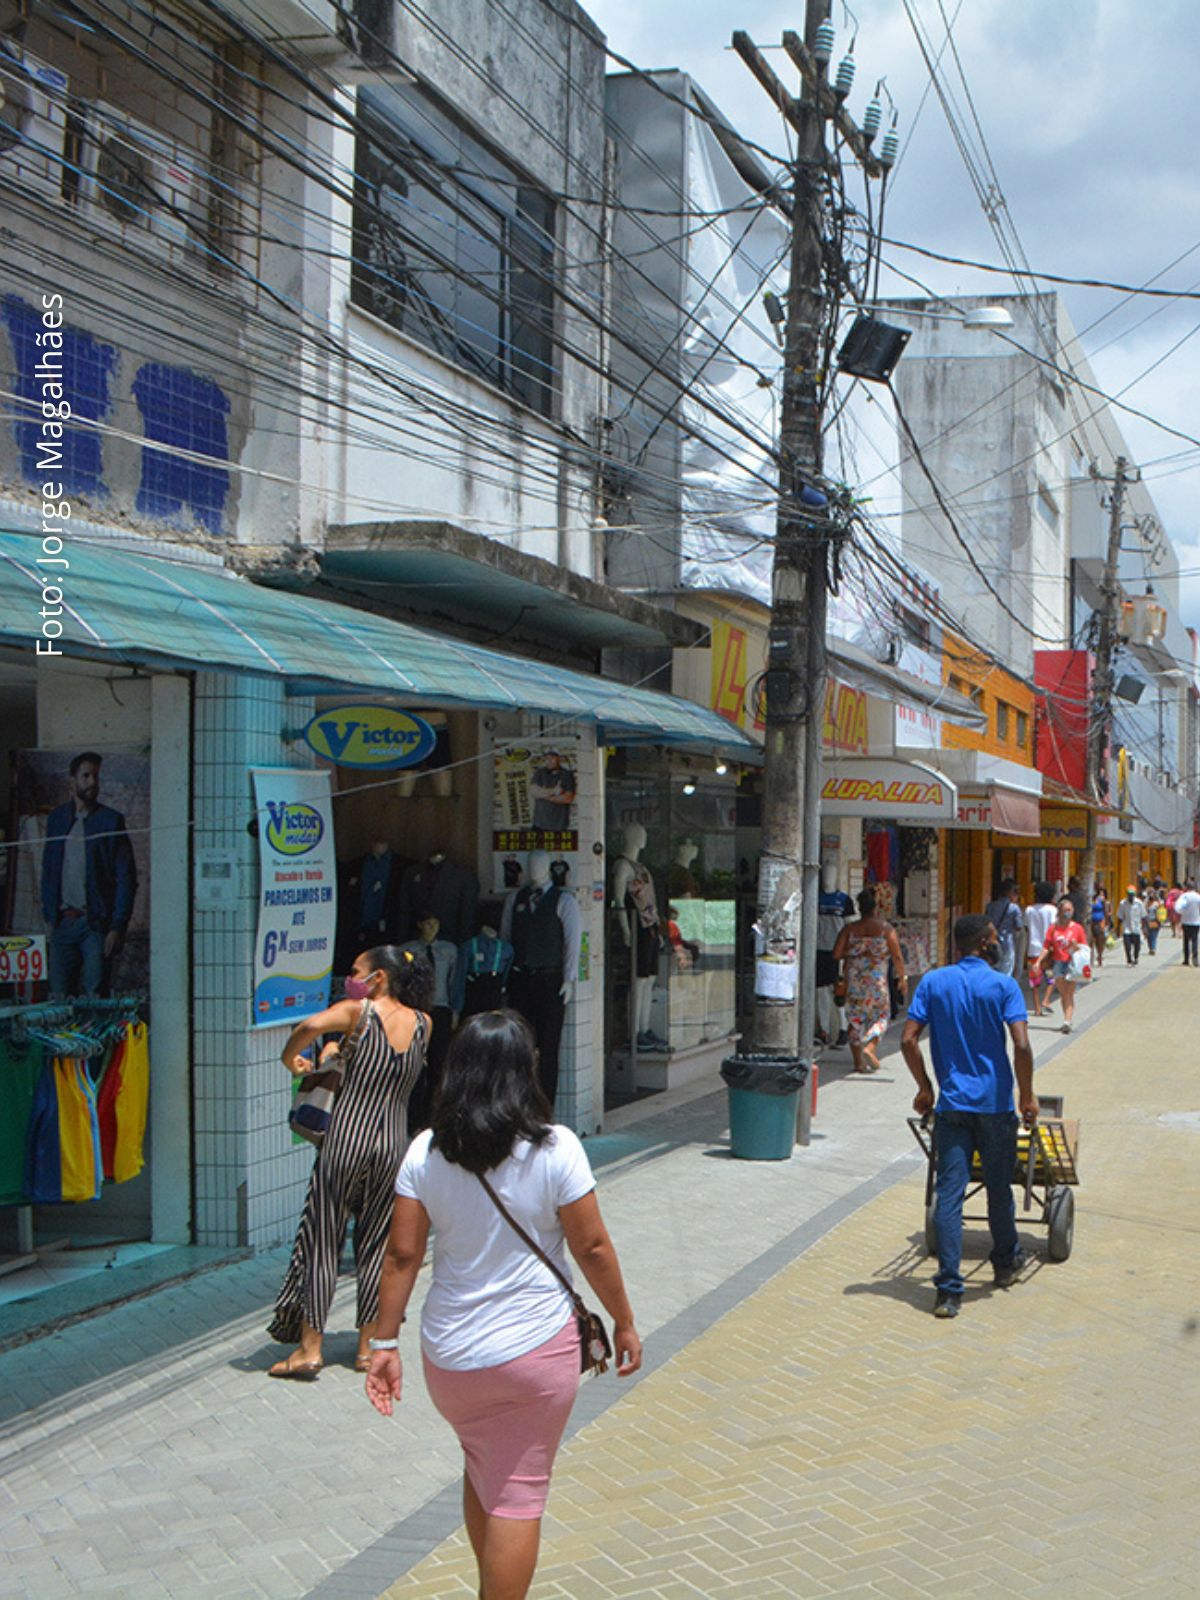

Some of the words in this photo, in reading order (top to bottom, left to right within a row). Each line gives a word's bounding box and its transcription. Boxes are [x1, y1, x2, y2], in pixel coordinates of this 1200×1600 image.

[317, 721, 420, 760] Victor
[265, 800, 319, 836] Victor
[263, 887, 319, 907] PARCELAMOS
[321, 886, 333, 902] EM
